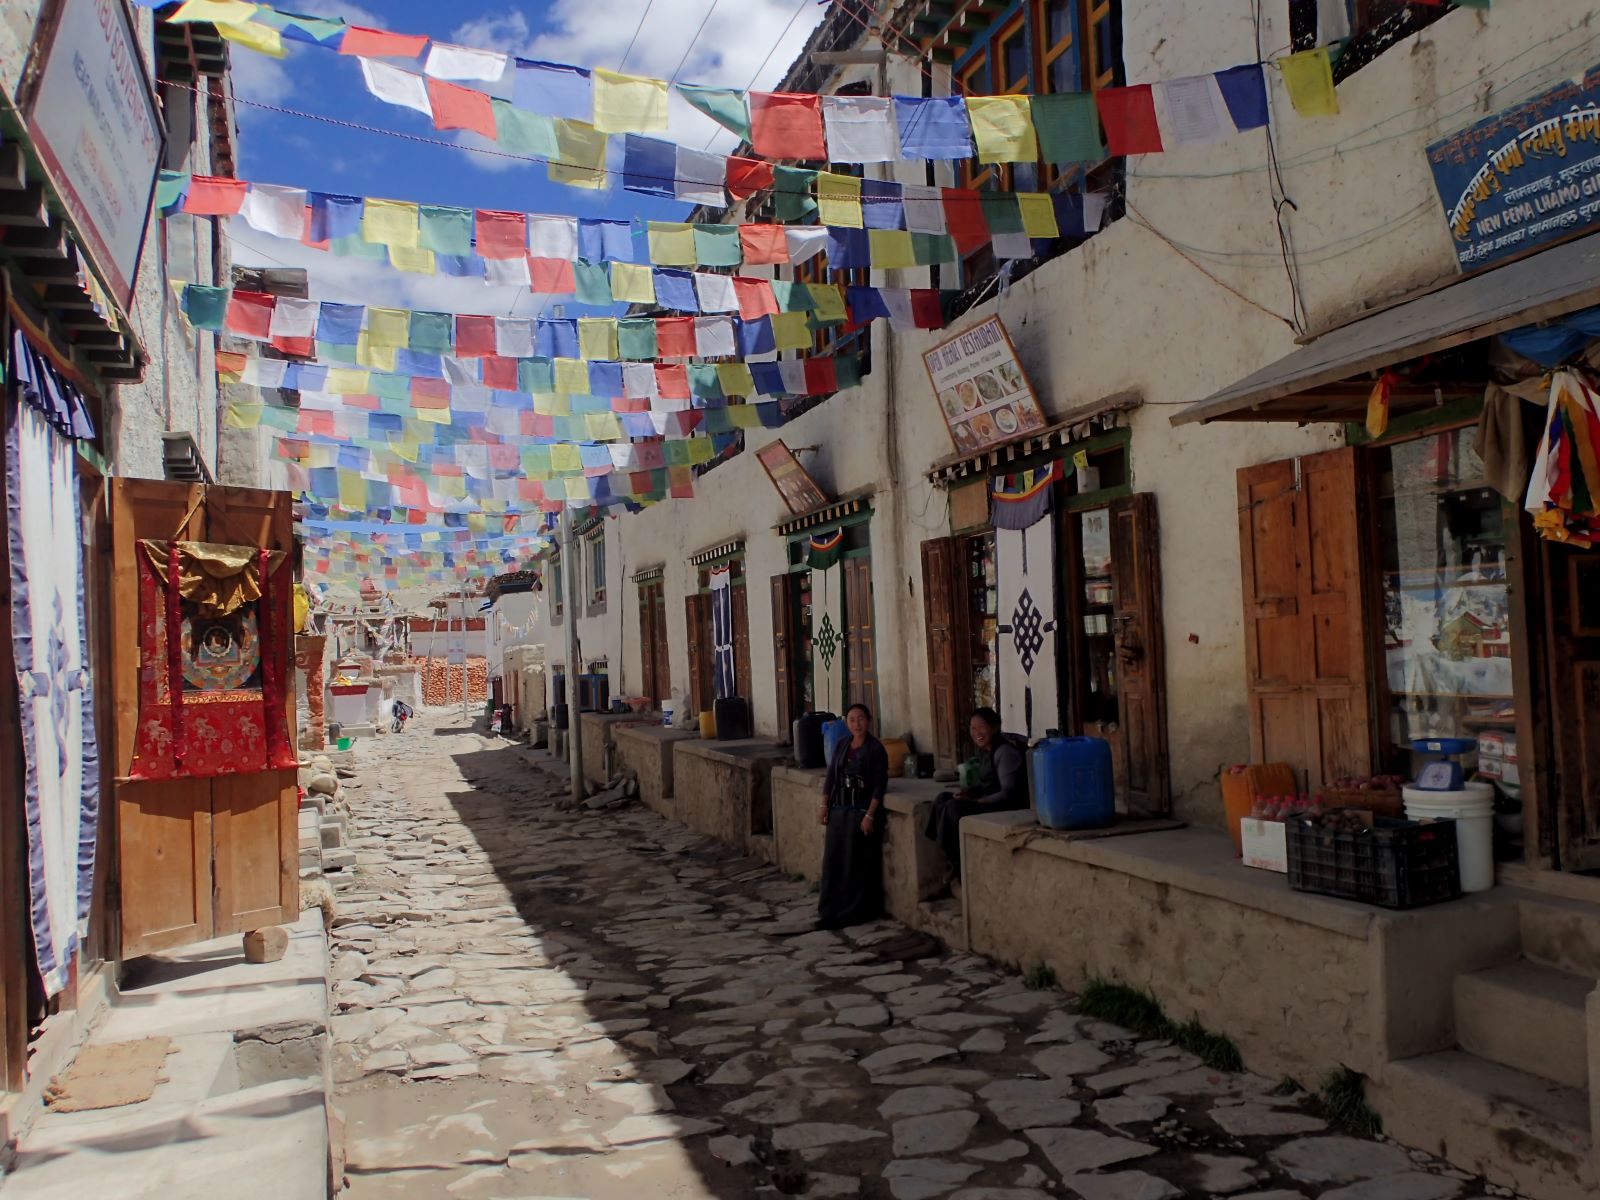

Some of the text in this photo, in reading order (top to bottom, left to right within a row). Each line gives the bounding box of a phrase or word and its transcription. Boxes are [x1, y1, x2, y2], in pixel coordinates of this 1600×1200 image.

[1476, 213, 1501, 236] NEW
[1502, 202, 1535, 226] PEMA
[1535, 183, 1580, 214] LHAMO
[941, 340, 962, 367] HEART
[959, 320, 1004, 357] RESTAURANT
